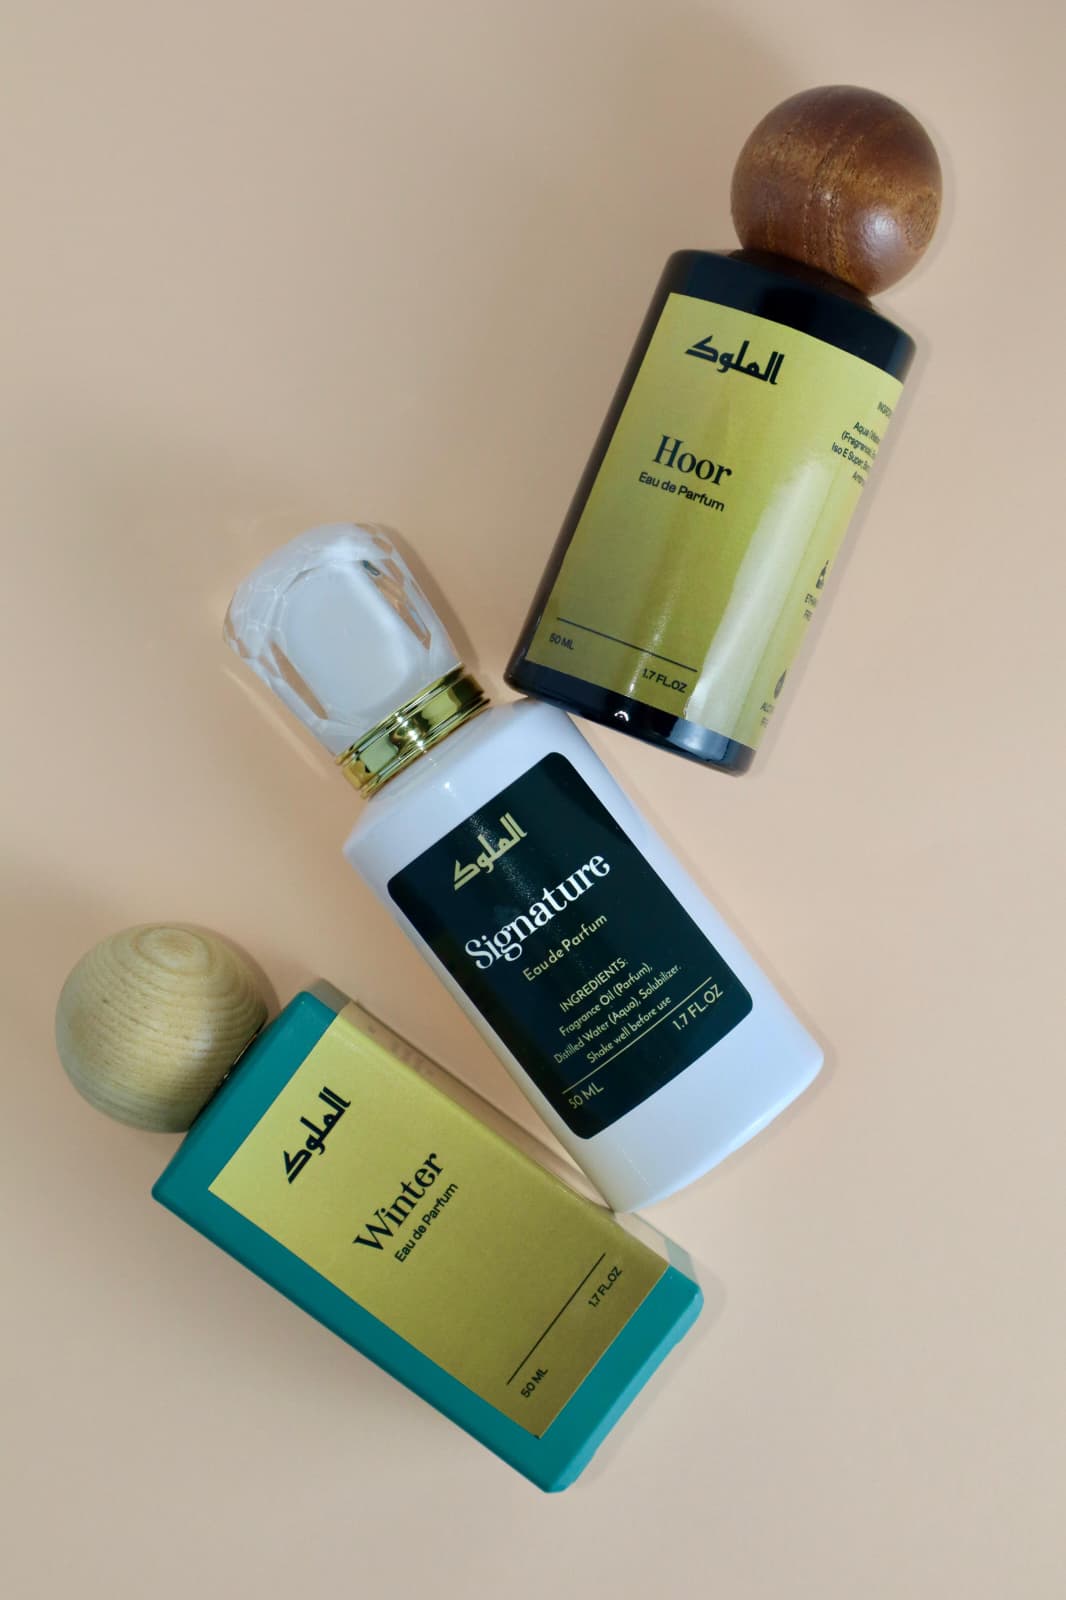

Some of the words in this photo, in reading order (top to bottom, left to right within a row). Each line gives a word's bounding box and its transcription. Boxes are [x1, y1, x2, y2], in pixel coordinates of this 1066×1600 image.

[684, 335, 785, 385] الملوك
[652, 434, 732, 486] Hoor
[842, 448, 849, 458] E
[638, 471, 660, 488] Eau
[661, 480, 677, 493] de
[677, 485, 725, 512] Parfum
[549, 632, 561, 645] 50
[561, 638, 574, 650] ML
[642, 668, 656, 680] 1.7
[453, 812, 528, 891] الملوك
[465, 855, 611, 969] Signature
[522, 963, 549, 982] Eau
[548, 949, 565, 964] de
[561, 915, 608, 952] Parfum
[558, 1004, 601, 1037] Fragrance
[600, 990, 615, 1006] Oil
[613, 962, 653, 997] (Parfum),
[559, 957, 629, 1013] INGREDIENTS:
[553, 1039, 585, 1064] Distilled
[582, 1022, 610, 1042] Water
[607, 996, 642, 1025] (Aqua),
[586, 1043, 614, 1064] Shake
[613, 1028, 631, 1045] well
[627, 1007, 657, 1032] before
[656, 996, 672, 1011] use
[672, 1013, 690, 1031] 1.7
[568, 1094, 583, 1109] 50
[581, 1081, 605, 1100] ML
[283, 1086, 351, 1185] الملوك
[352, 1153, 444, 1251] Winter
[394, 1239, 416, 1263] Eau
[412, 1224, 428, 1241] de
[421, 1183, 459, 1226] Parfum
[588, 1293, 601, 1308] 1.7
[520, 1382, 536, 1399] 50
[531, 1368, 549, 1384] ML
